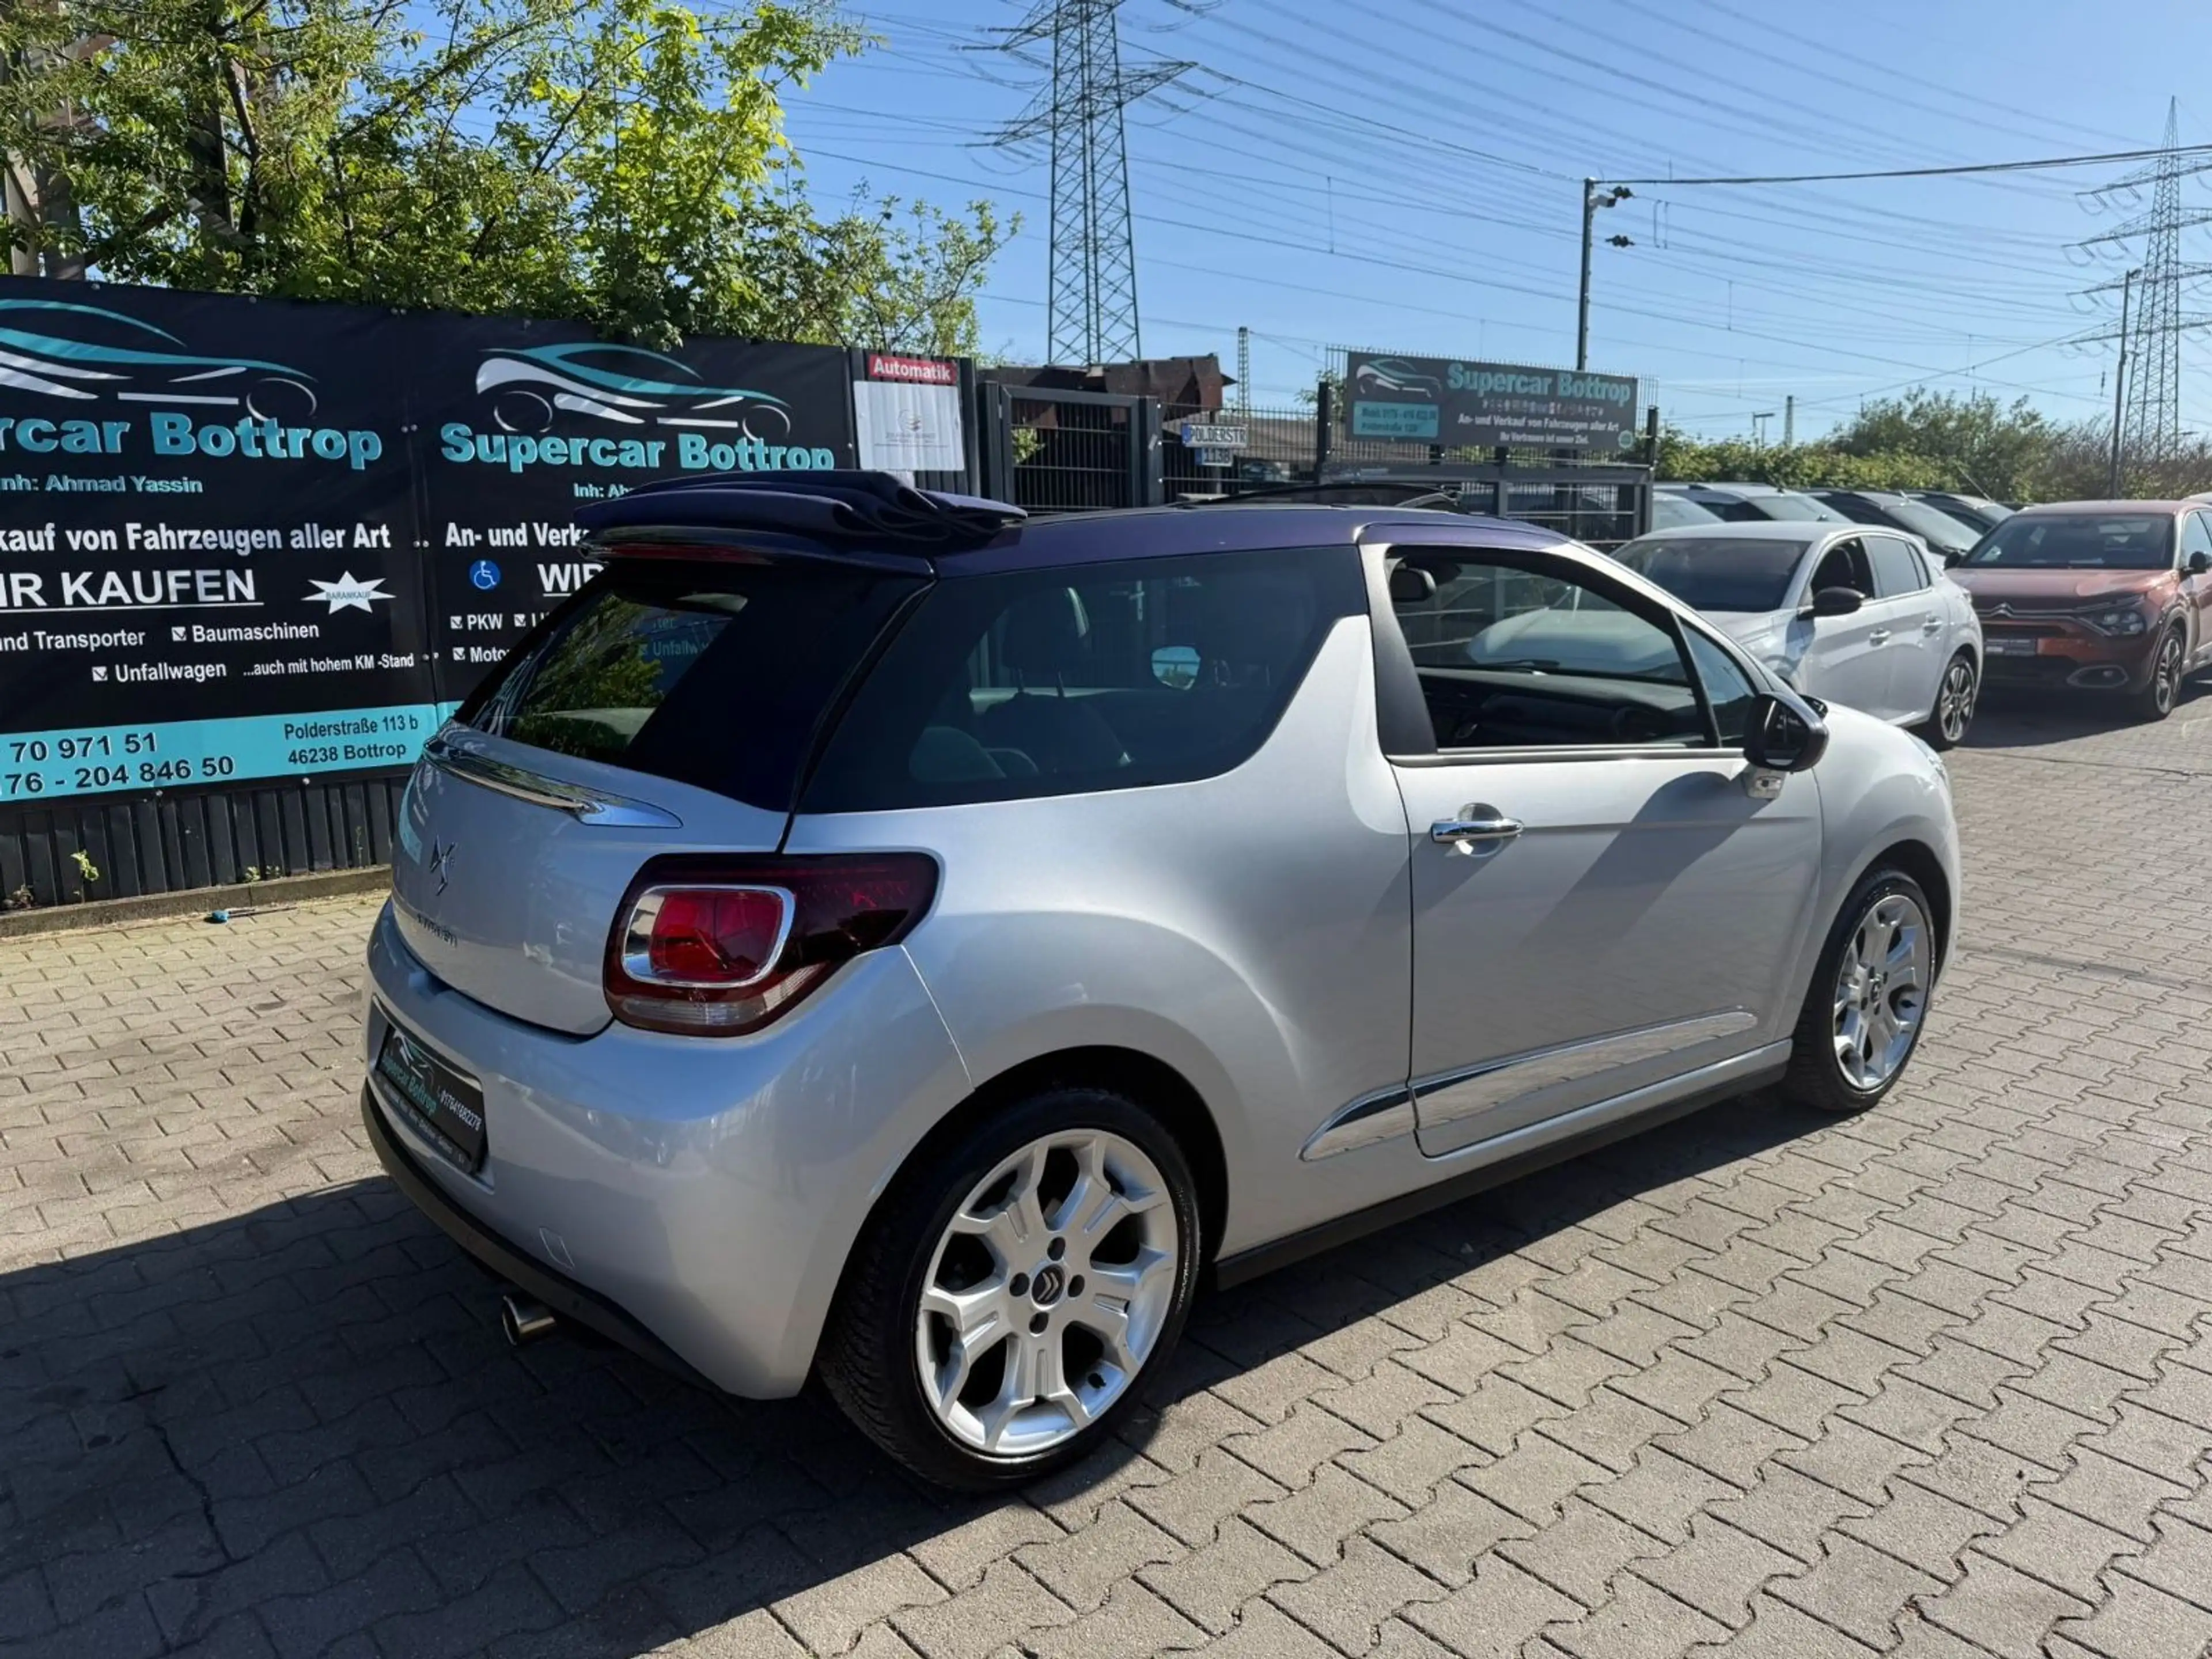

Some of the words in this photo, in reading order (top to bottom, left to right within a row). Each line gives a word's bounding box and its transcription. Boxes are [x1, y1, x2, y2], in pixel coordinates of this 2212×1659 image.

[874, 357, 951, 381] Automatik
[1447, 362, 1552, 397] Supercar
[1558, 373, 1631, 407] Bottrop
[1493, 415, 1525, 426] Verkauf
[1544, 417, 1589, 433] Fahrzeugen
[150, 411, 382, 470] Bottrop
[441, 422, 666, 472] Supercar
[678, 433, 834, 471] Bottrop
[46, 474, 126, 493] Ahmad
[130, 476, 203, 494] Yassin
[574, 482, 604, 498] Inh:
[66, 529, 118, 551] von
[126, 522, 282, 556] Fahrzeugen
[290, 522, 346, 549] aller
[353, 522, 391, 549] Art
[445, 522, 482, 547] An-
[488, 522, 528, 547] und
[60, 569, 256, 606] KAUFEN
[326, 591, 372, 600] BARANKAUF
[467, 613, 503, 631] PKW
[0, 632, 29, 652] nd
[33, 629, 146, 652] Transporter
[192, 622, 320, 643] Baumaschinen
[243, 660, 285, 676] ...auch
[288, 658, 308, 674] mit
[311, 657, 353, 673] hohem
[355, 655, 374, 669] KM
[377, 653, 415, 668] -Stand
[470, 646, 510, 663] Moto
[115, 662, 227, 683] Unfallwagen
[284, 718, 378, 740] Polderstraße
[383, 715, 405, 732] 113
[410, 714, 418, 730] b
[9, 741, 48, 763] 70
[58, 736, 111, 759] 971
[124, 732, 157, 753] 51
[288, 746, 339, 765] 46238
[344, 743, 407, 760] Bottrop
[5, 772, 44, 795] 76
[75, 764, 130, 789] 204
[139, 759, 192, 782] 846
[202, 755, 236, 777] 50
